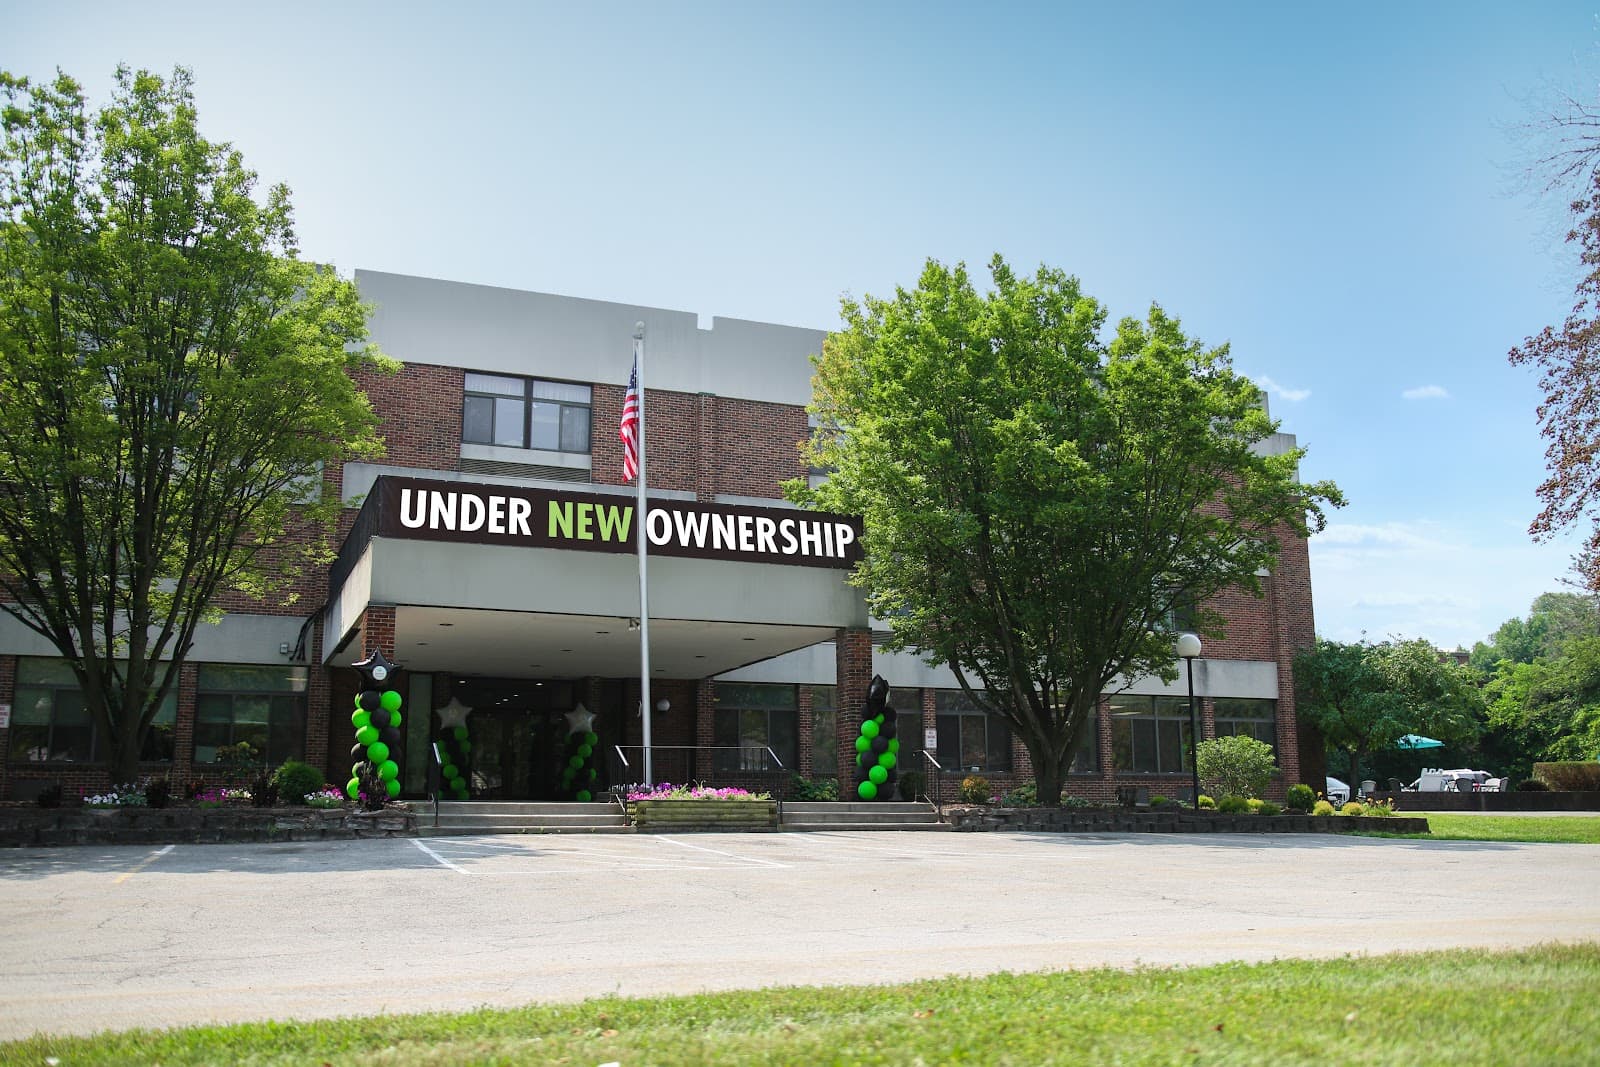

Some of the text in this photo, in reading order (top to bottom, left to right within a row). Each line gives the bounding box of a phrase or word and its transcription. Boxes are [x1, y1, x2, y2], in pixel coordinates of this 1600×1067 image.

[400, 488, 855, 559] UNDER NEW OWNERSHIP
